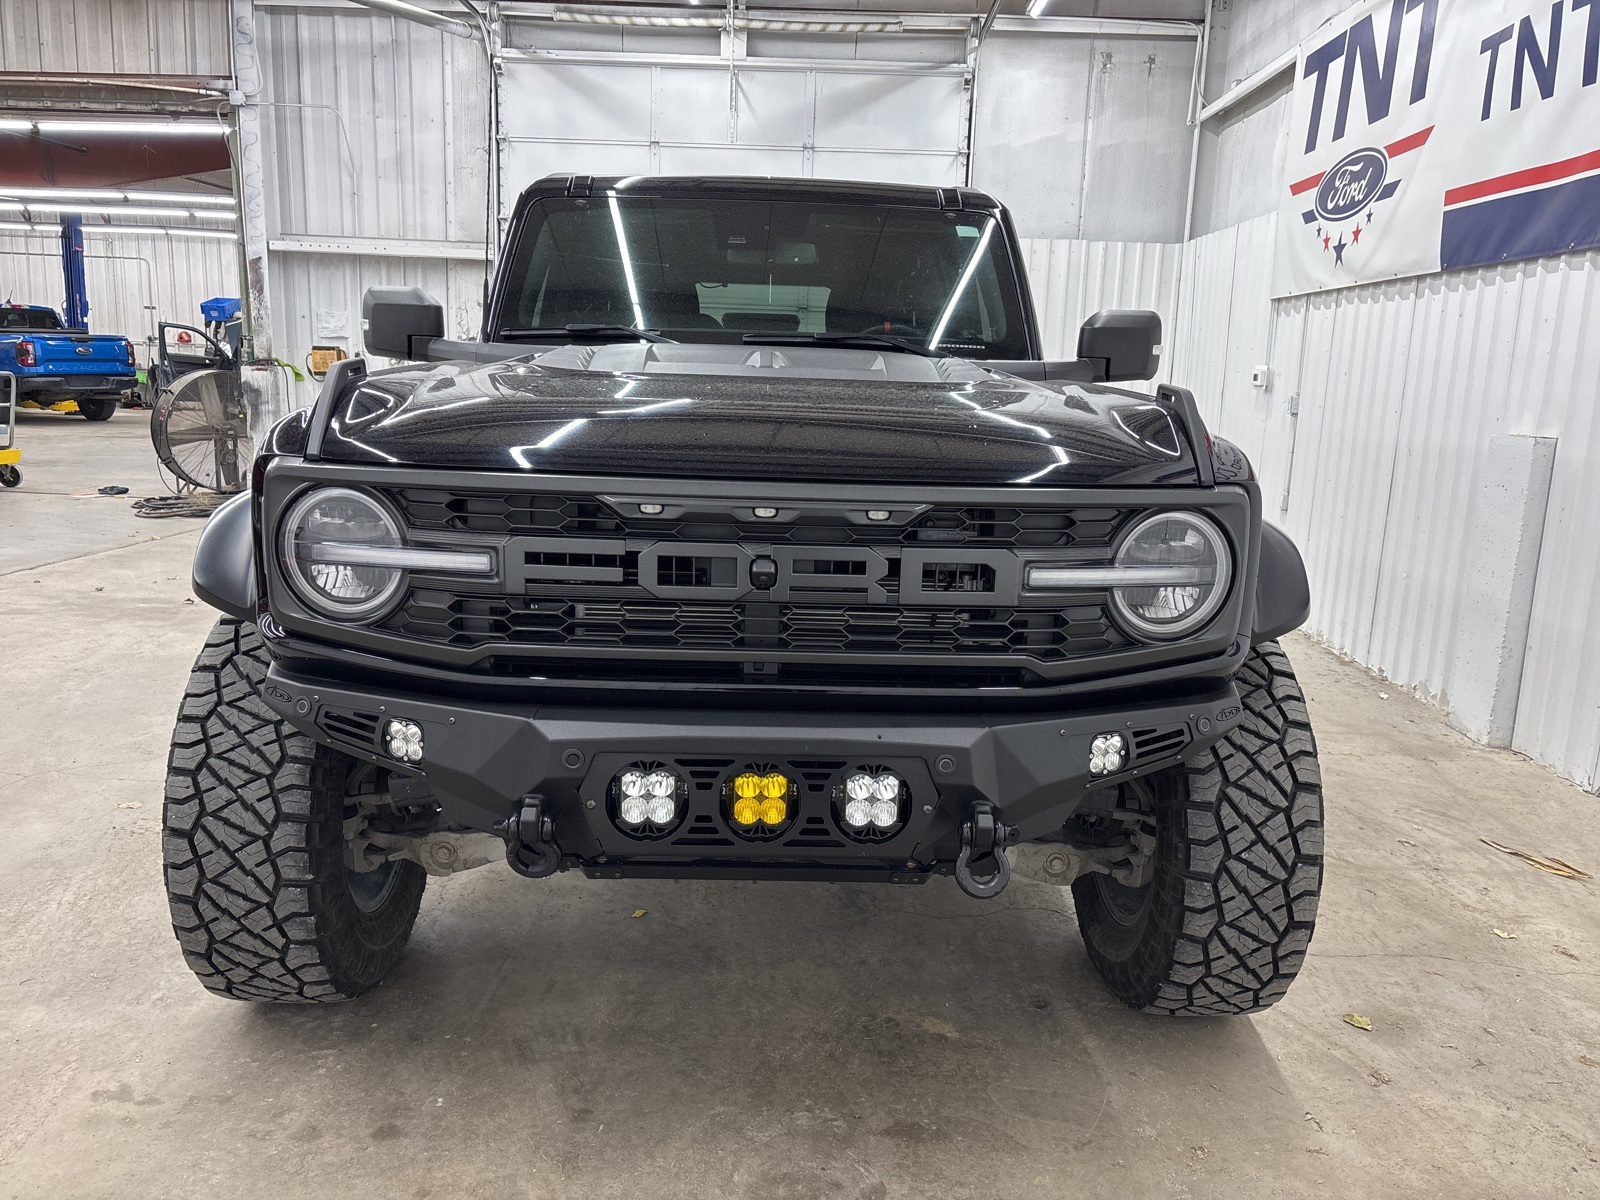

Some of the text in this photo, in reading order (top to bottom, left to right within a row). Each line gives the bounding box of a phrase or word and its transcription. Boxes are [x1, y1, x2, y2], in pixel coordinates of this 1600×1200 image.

[1303, 0, 1439, 155] TNT
[1327, 161, 1373, 210] Ford
[504, 536, 1018, 605] FORD
